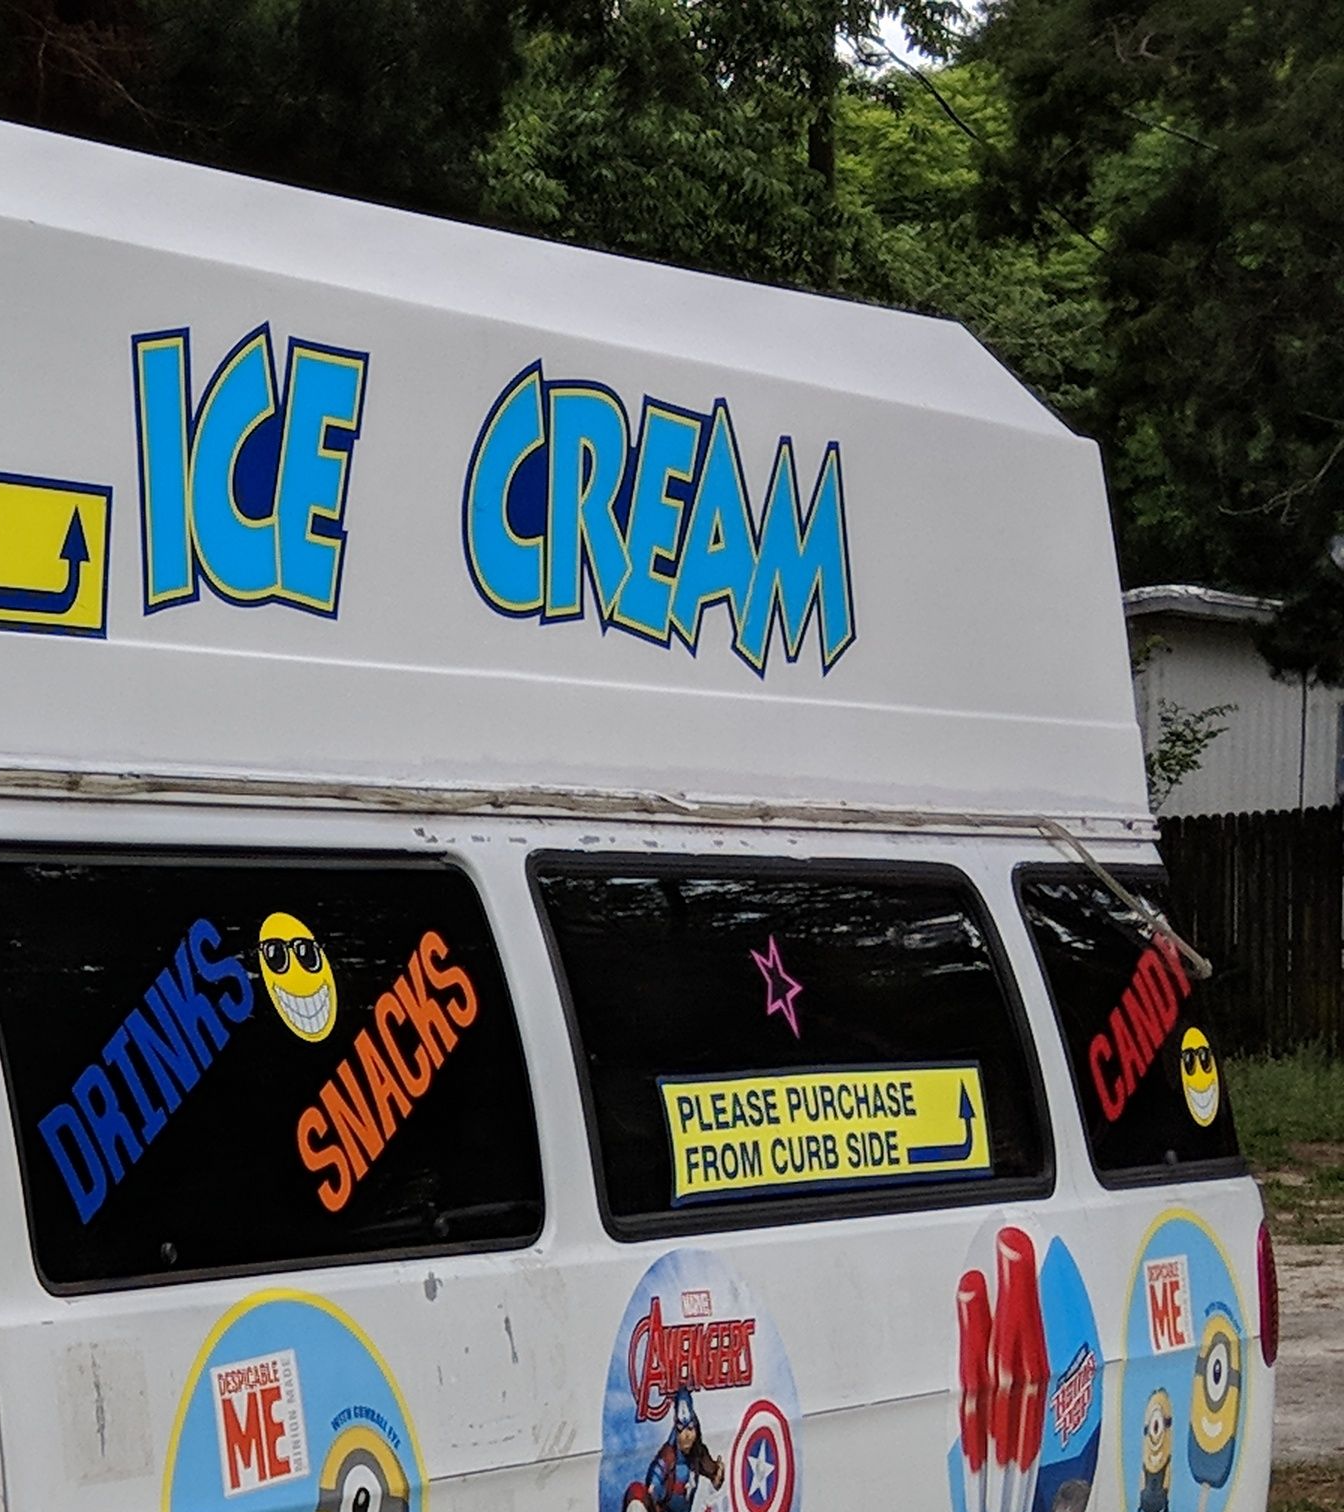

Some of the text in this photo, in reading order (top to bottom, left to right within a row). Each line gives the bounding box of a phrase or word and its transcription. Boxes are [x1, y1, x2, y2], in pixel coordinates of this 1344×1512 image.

[132, 321, 857, 679] ICE CREAM
[38, 918, 254, 1225] DRINKS
[297, 931, 478, 1213] SNACKS
[676, 1081, 917, 1134] PLEASE PURCHASE
[685, 1131, 901, 1184] FROM CURB SIDE
[628, 1296, 756, 1423] AVENGERS
[1149, 1280, 1185, 1351] ME
[217, 1360, 280, 1395] DESPICABLE
[282, 1358, 303, 1473] MINION MADE
[221, 1386, 291, 1490] ME
